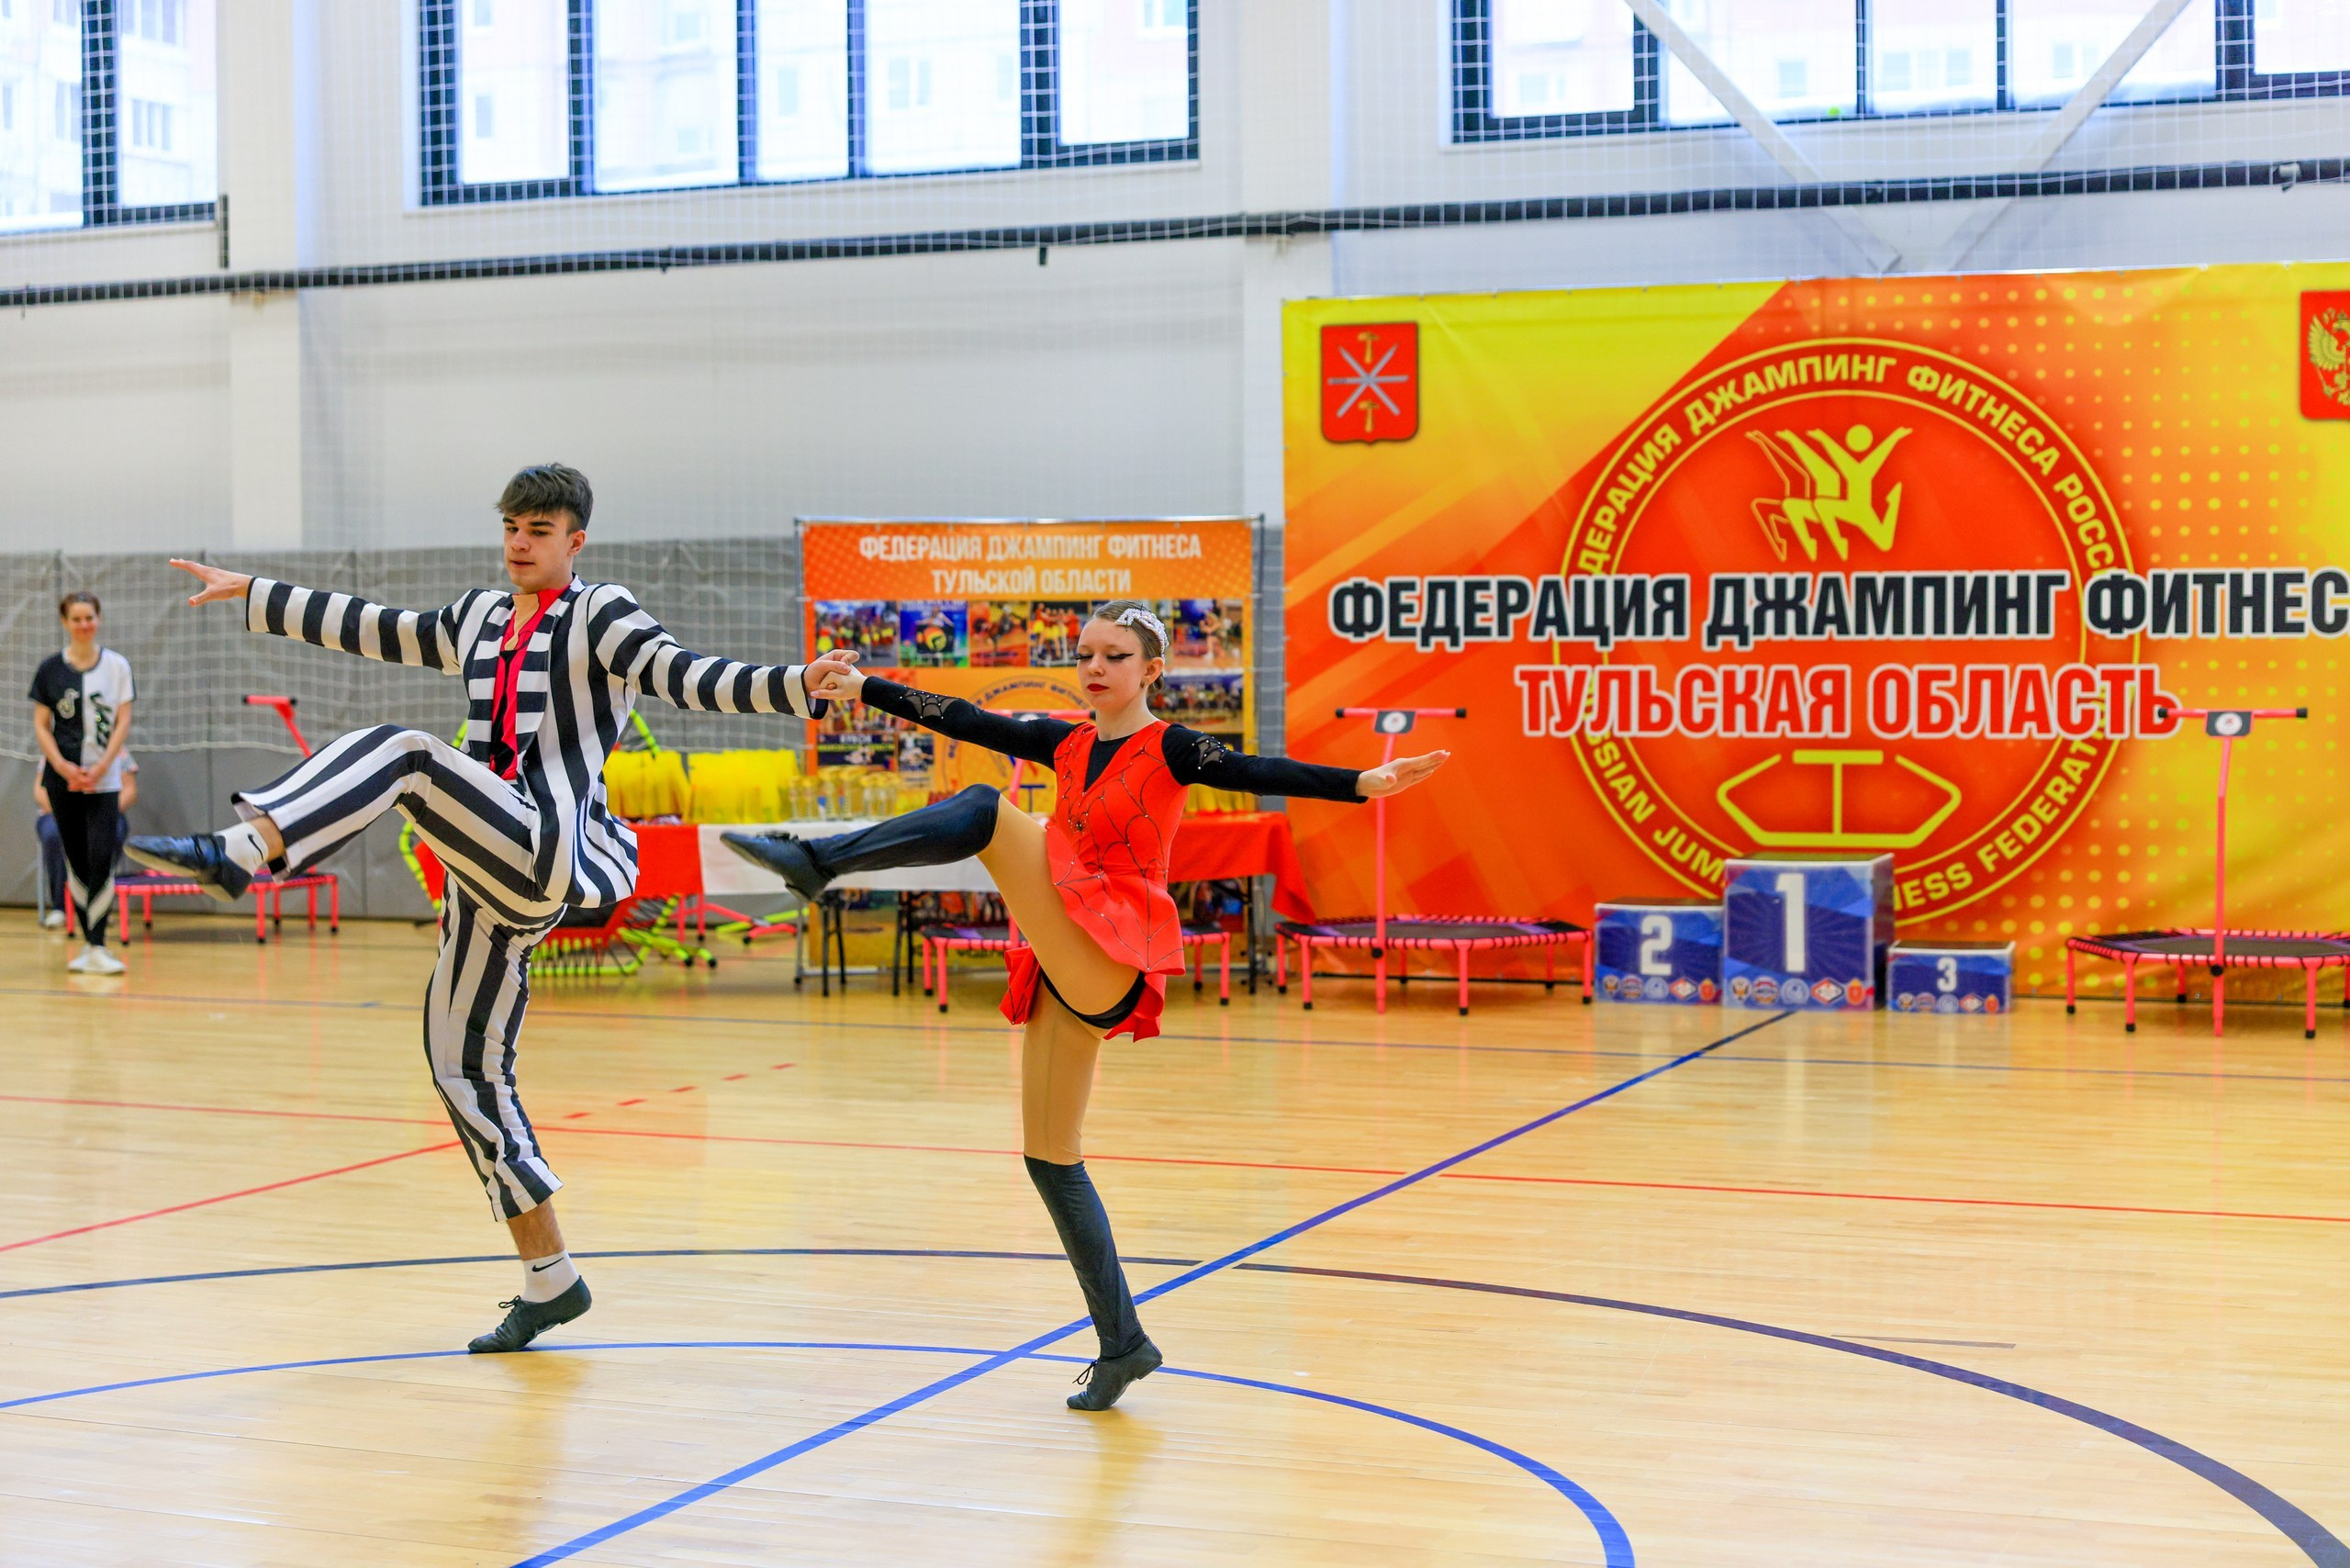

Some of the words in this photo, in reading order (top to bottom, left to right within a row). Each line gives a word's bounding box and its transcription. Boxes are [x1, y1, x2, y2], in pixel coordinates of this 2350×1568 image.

[1577, 422, 1683, 576] ДЕРАЦИЯ
[1685, 353, 1897, 437] ДЖАМПИНГ
[1907, 364, 2062, 476] ФИТНЕСА
[2053, 472, 2117, 576] РОСС
[859, 533, 982, 563] ФЕДЕРАЦИЯ
[987, 533, 1102, 563] ДЖАМПИНГ
[1107, 532, 1202, 561] ФИТНЕСА
[932, 567, 1036, 596] ТУЛЬСКОЙ
[1040, 566, 1132, 595] ОБЛАСТИ
[1330, 574, 1689, 651] ФЕДЕРАЦИЯ
[1704, 570, 2070, 651] ДЖАМПИНГ
[2086, 566, 2350, 640] ФИТНЕС
[1515, 665, 1852, 739] ТУЛЬСКАЯ
[1867, 663, 2182, 740] ОБЛАСТЬ
[1653, 825, 1725, 889] JUM
[1975, 684, 2107, 874] FEDERAT
[1639, 915, 1673, 976] 2
[1775, 873, 1806, 973] 1
[1937, 958, 1957, 992] 3
